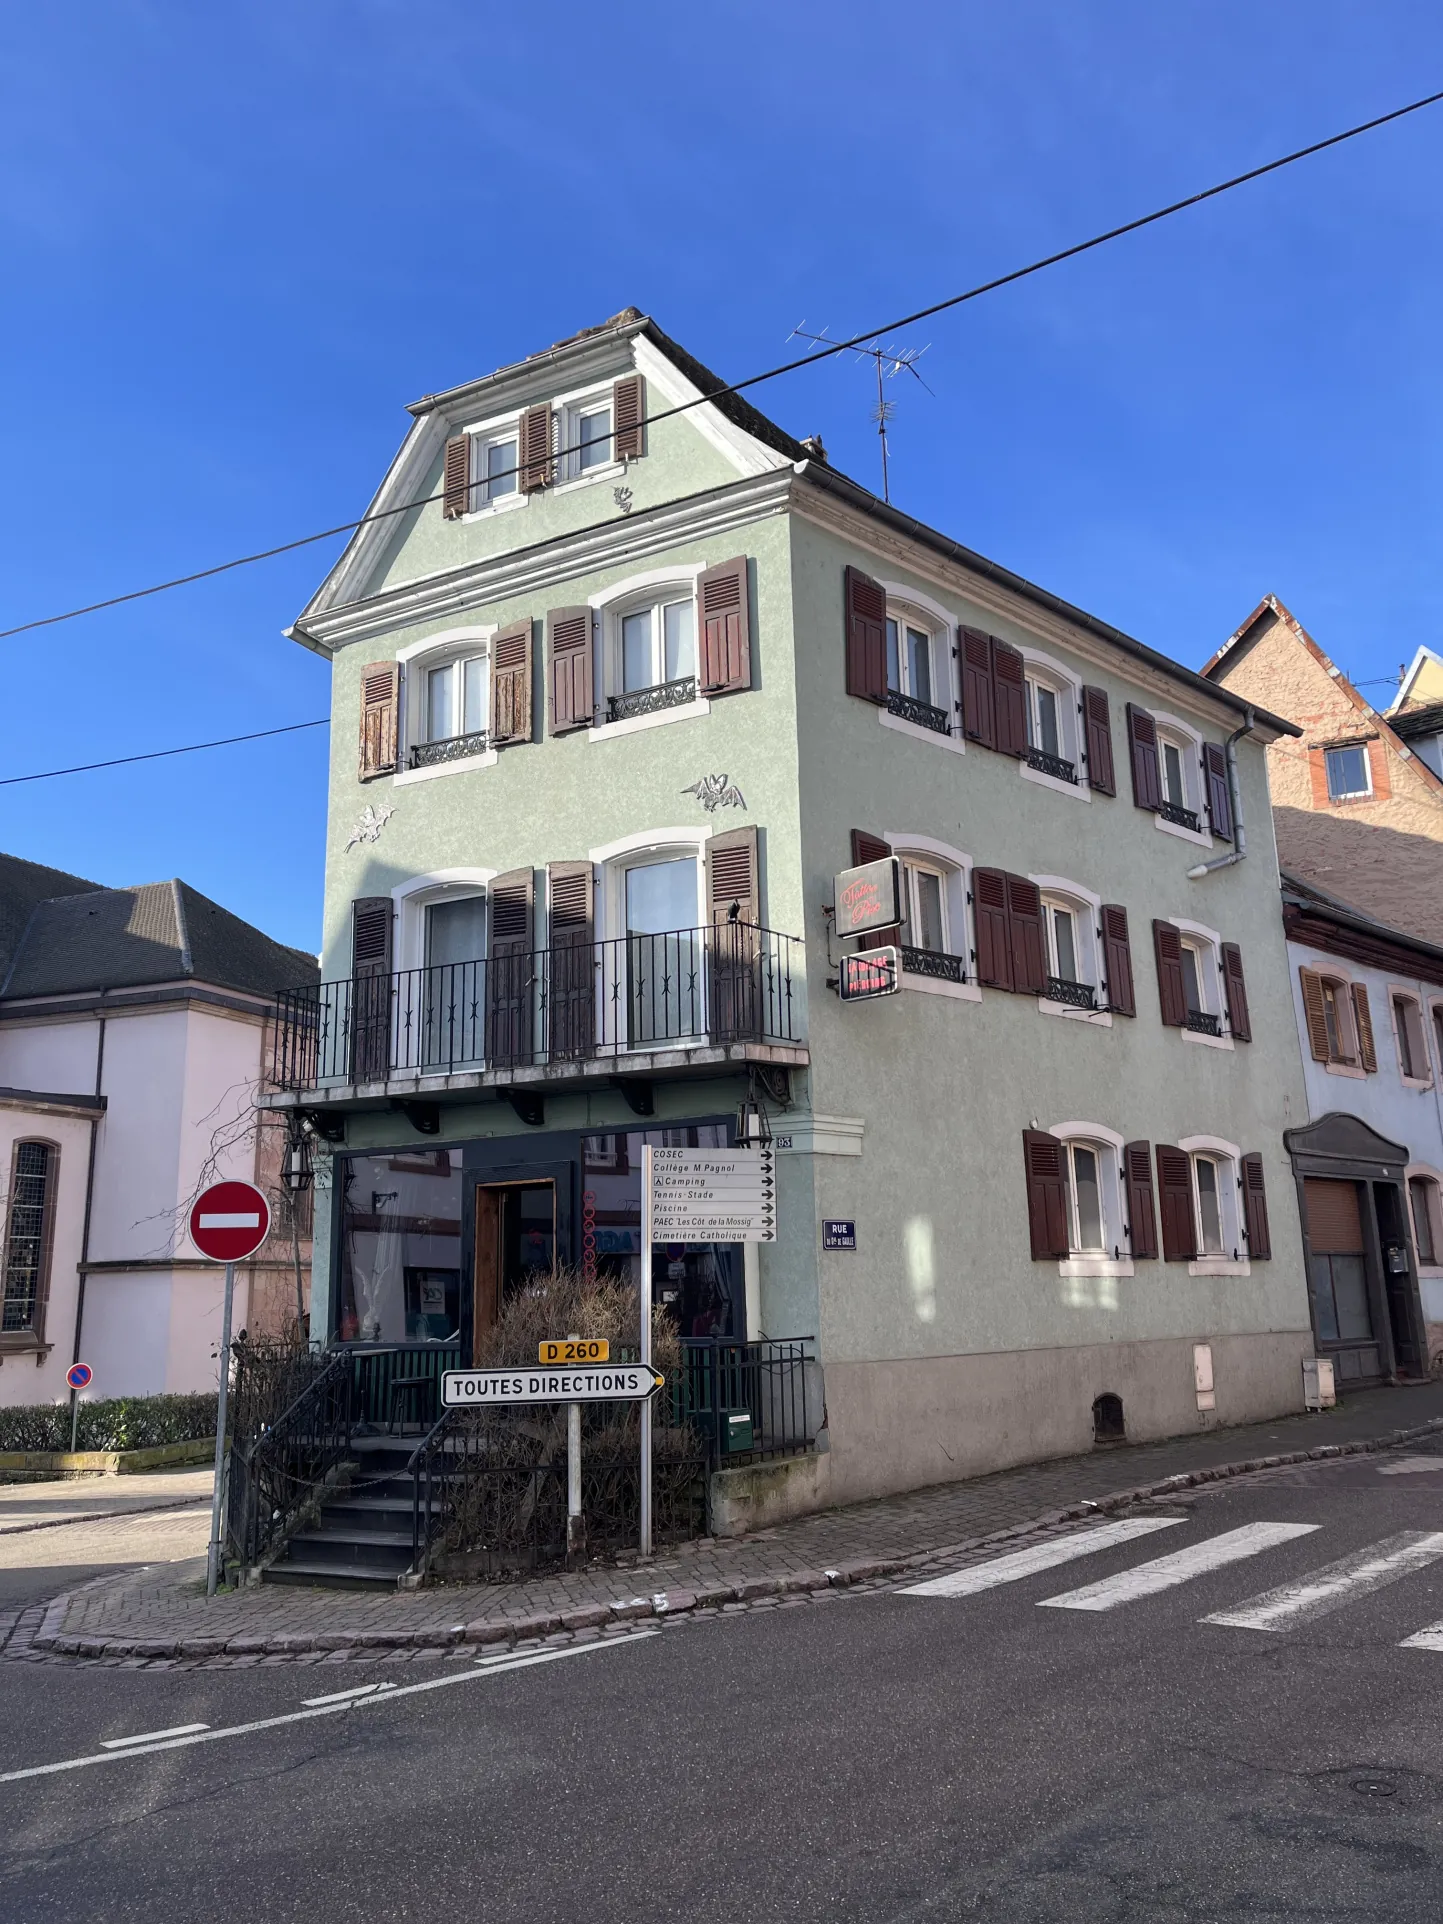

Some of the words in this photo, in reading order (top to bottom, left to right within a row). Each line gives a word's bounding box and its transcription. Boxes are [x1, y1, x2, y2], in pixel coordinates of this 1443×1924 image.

[778, 1137, 790, 1147] 93
[653, 1150, 684, 1159] COSEC
[653, 1163, 689, 1174] Collège
[665, 1177, 706, 1187] Camping
[653, 1203, 688, 1212] Piscine
[653, 1217, 674, 1226] PAEC
[708, 1217, 717, 1226] de
[718, 1217, 725, 1226] la
[832, 1225, 848, 1234] RUE
[653, 1231, 696, 1240] Cimetière
[700, 1231, 747, 1241] Catholique
[838, 1238, 842, 1246] DE
[842, 1237, 854, 1246] GAULLE
[547, 1344, 558, 1360] D
[565, 1342, 600, 1359] 260
[453, 1378, 523, 1397] TOUTES
[529, 1374, 639, 1394] DIRECTIONS
